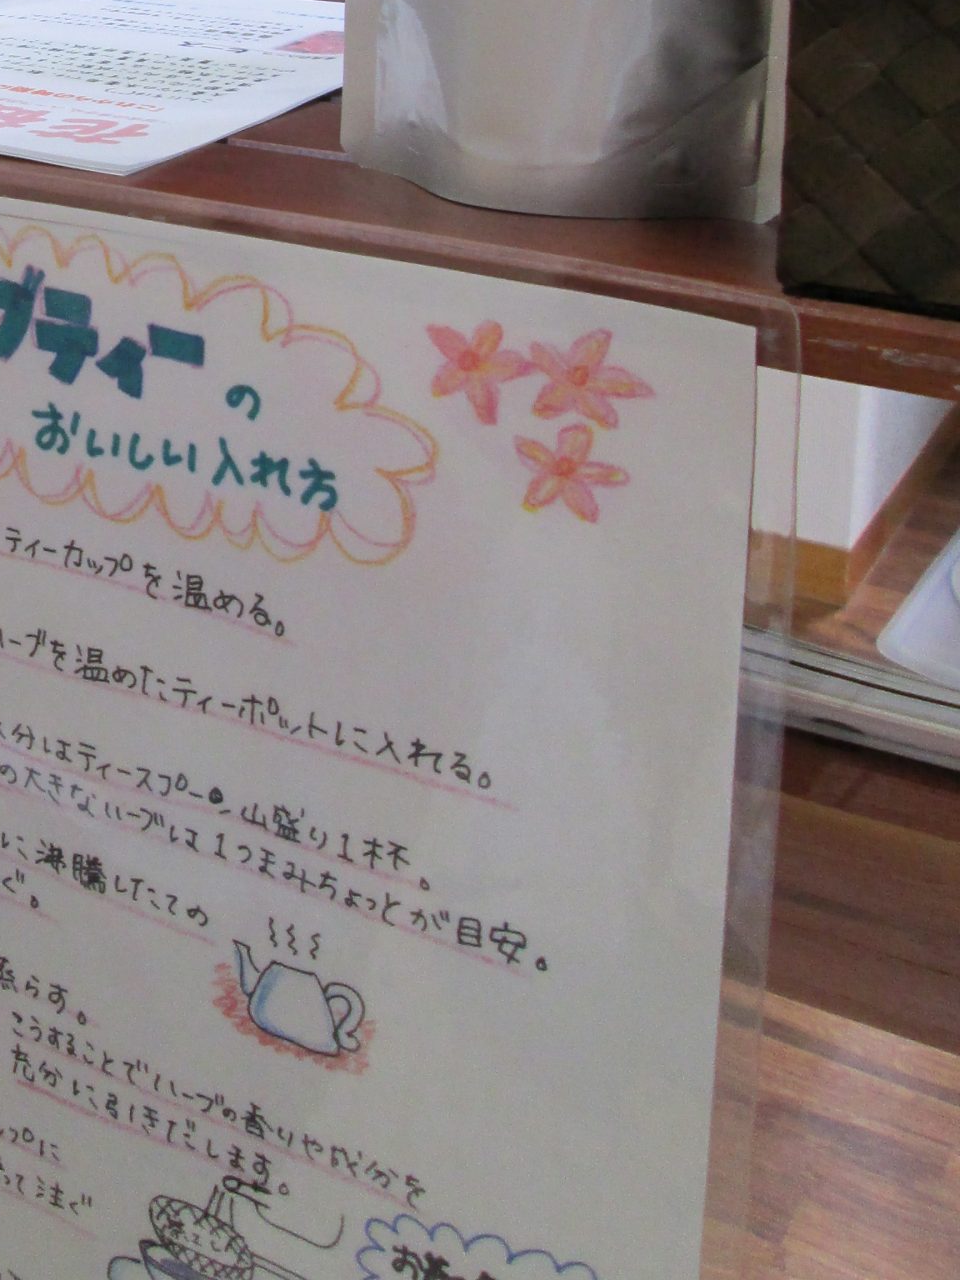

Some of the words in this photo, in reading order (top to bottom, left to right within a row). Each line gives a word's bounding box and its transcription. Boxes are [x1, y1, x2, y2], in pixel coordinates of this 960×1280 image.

[31, 402, 338, 511] おいしい入れ方
